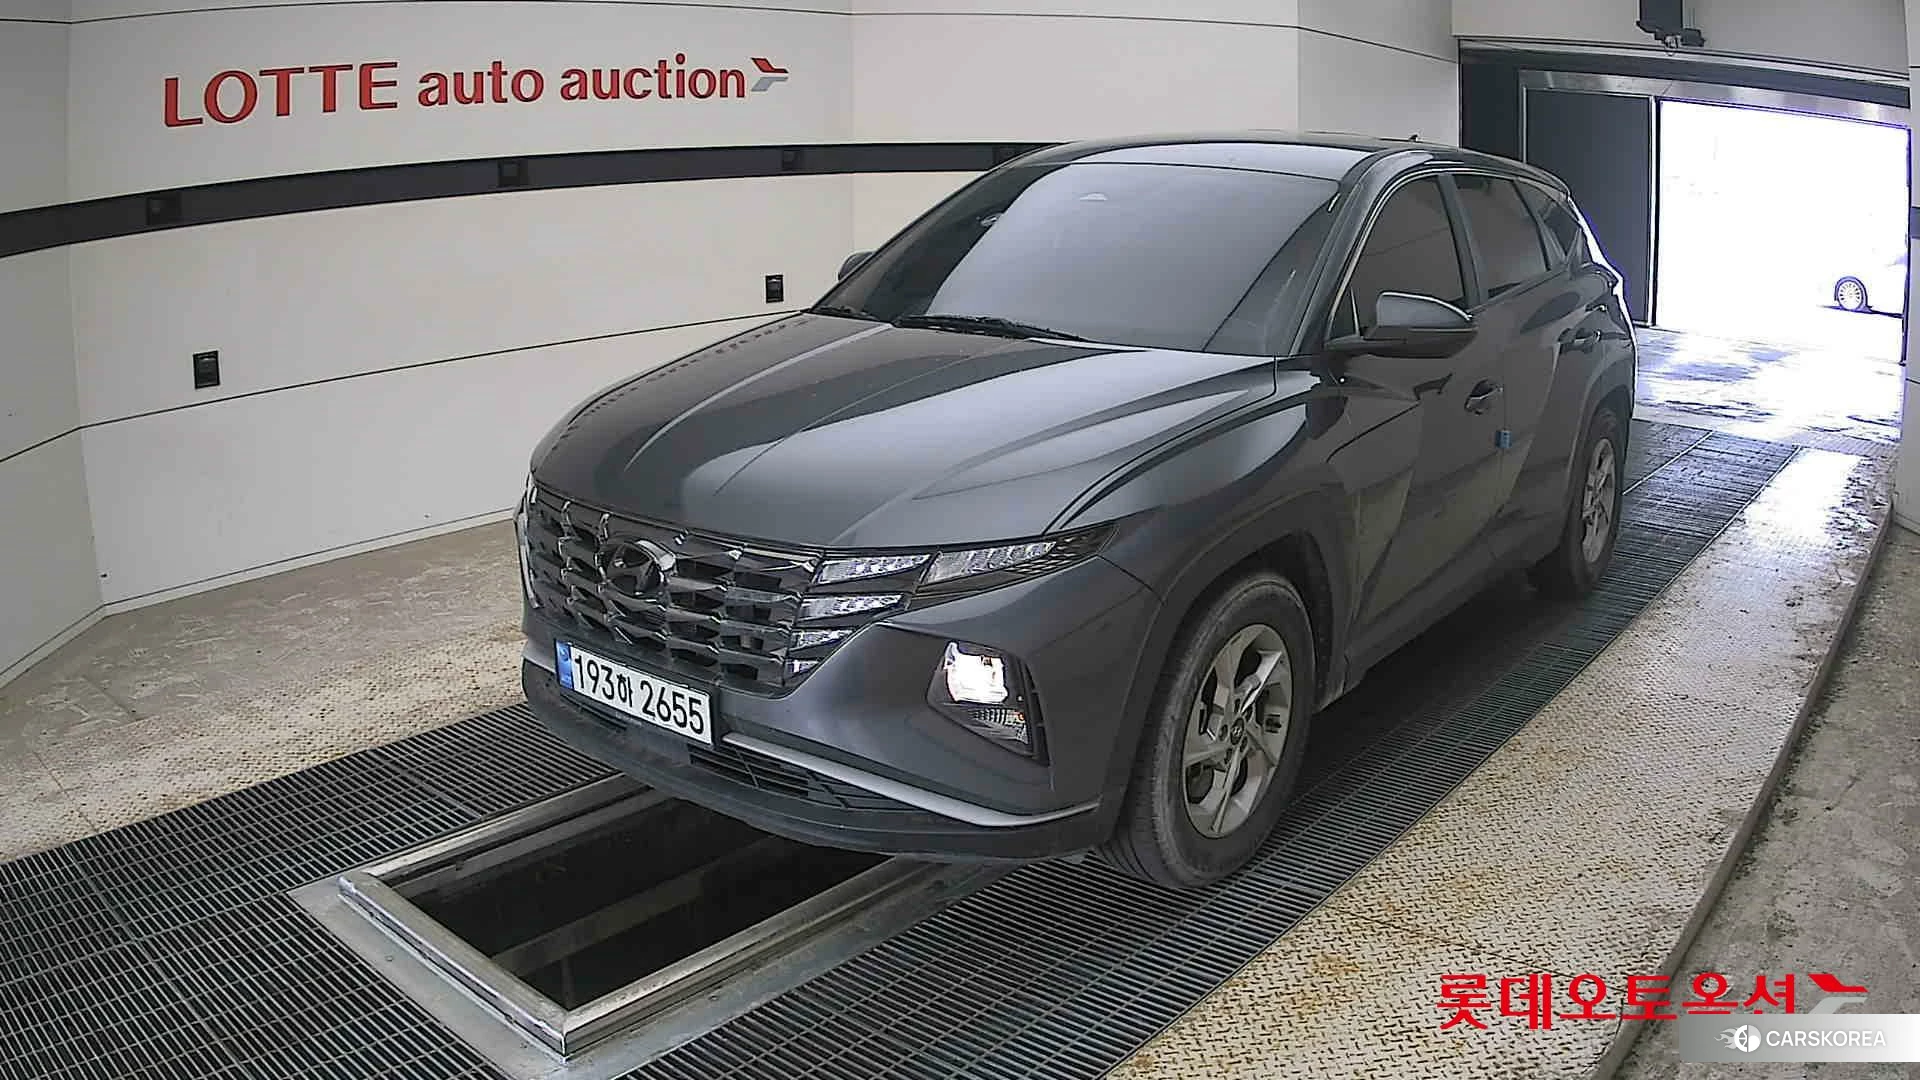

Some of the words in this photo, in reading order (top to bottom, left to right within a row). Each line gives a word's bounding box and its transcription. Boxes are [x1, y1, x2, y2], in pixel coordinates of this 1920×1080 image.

[164, 61, 398, 127] LOTTE
[418, 60, 545, 106] auto
[560, 53, 747, 100] auction
[574, 655, 633, 707] 193하
[640, 680, 704, 735] 2655
